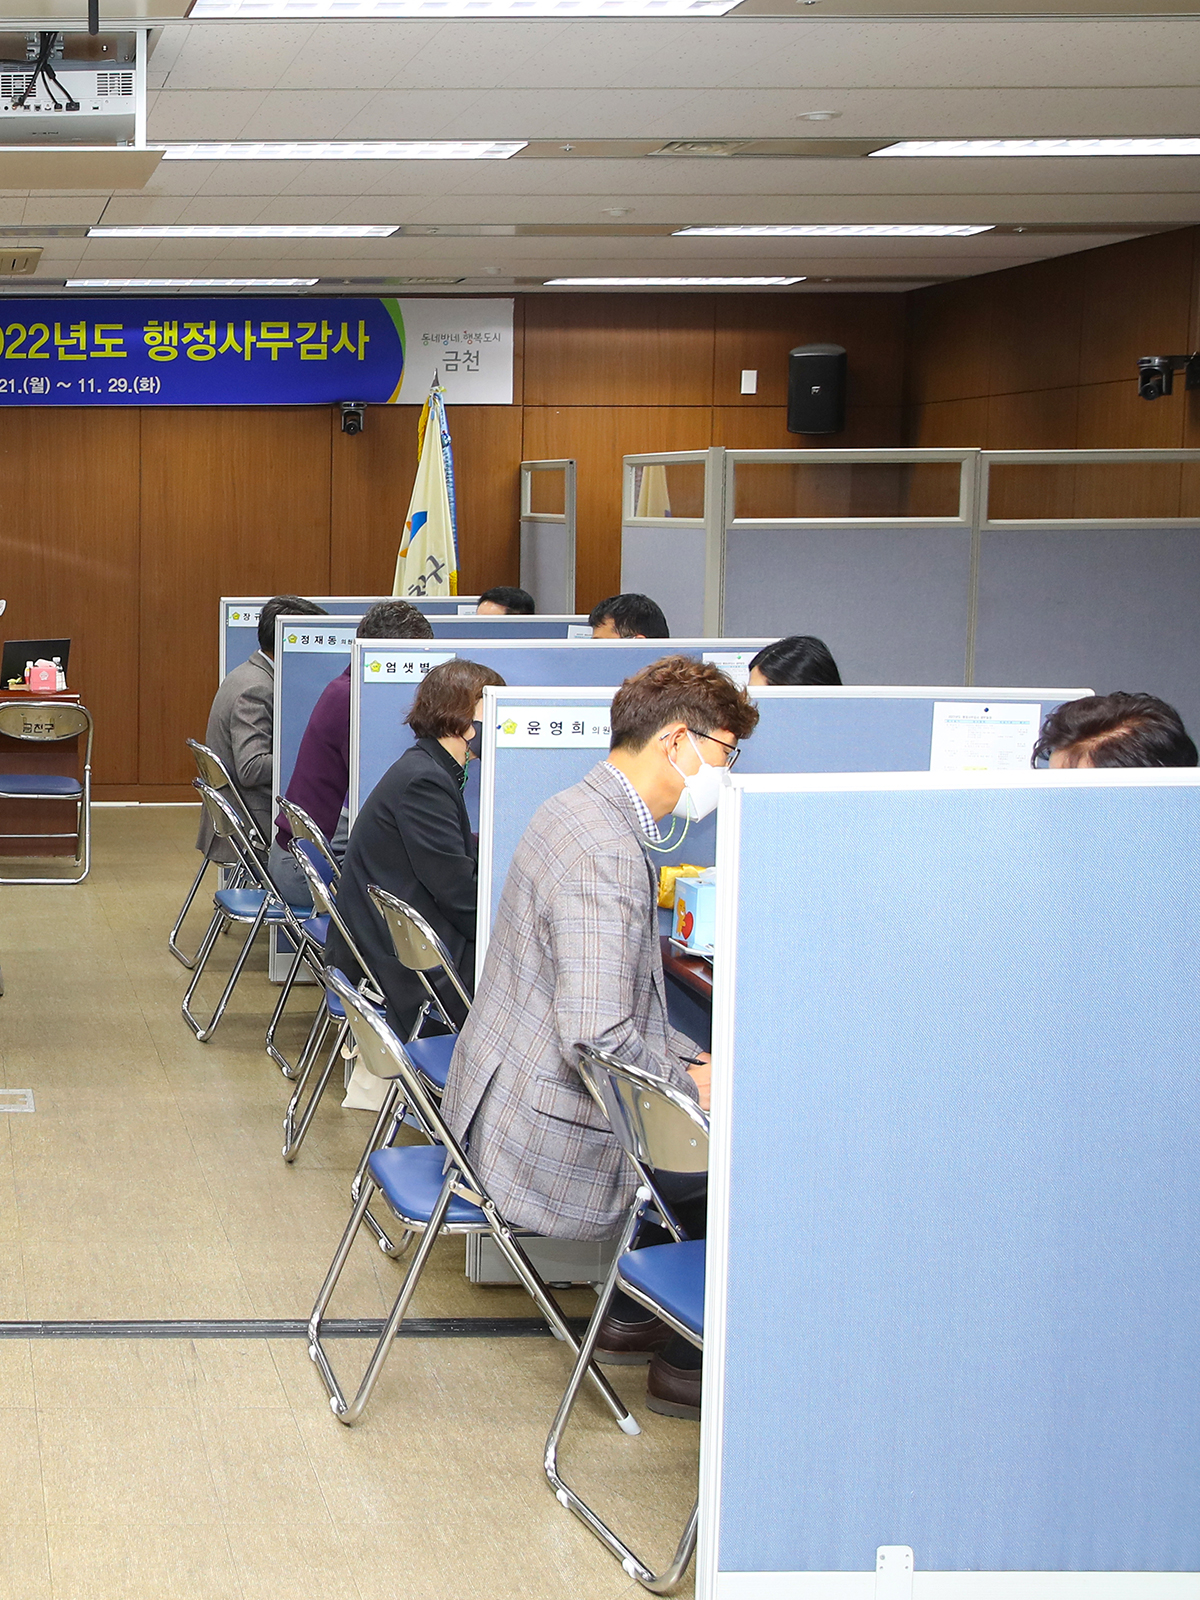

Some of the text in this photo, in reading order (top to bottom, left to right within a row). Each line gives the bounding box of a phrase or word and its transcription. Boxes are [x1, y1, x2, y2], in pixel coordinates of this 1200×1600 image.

[143, 320, 370, 362] 행정사무감사
[442, 350, 480, 372] 금천
[78, 378, 102, 394] 11.
[108, 376, 161, 394] 29.(화)
[301, 635, 337, 646] 정재동
[527, 721, 611, 736] 윤영희 의원
